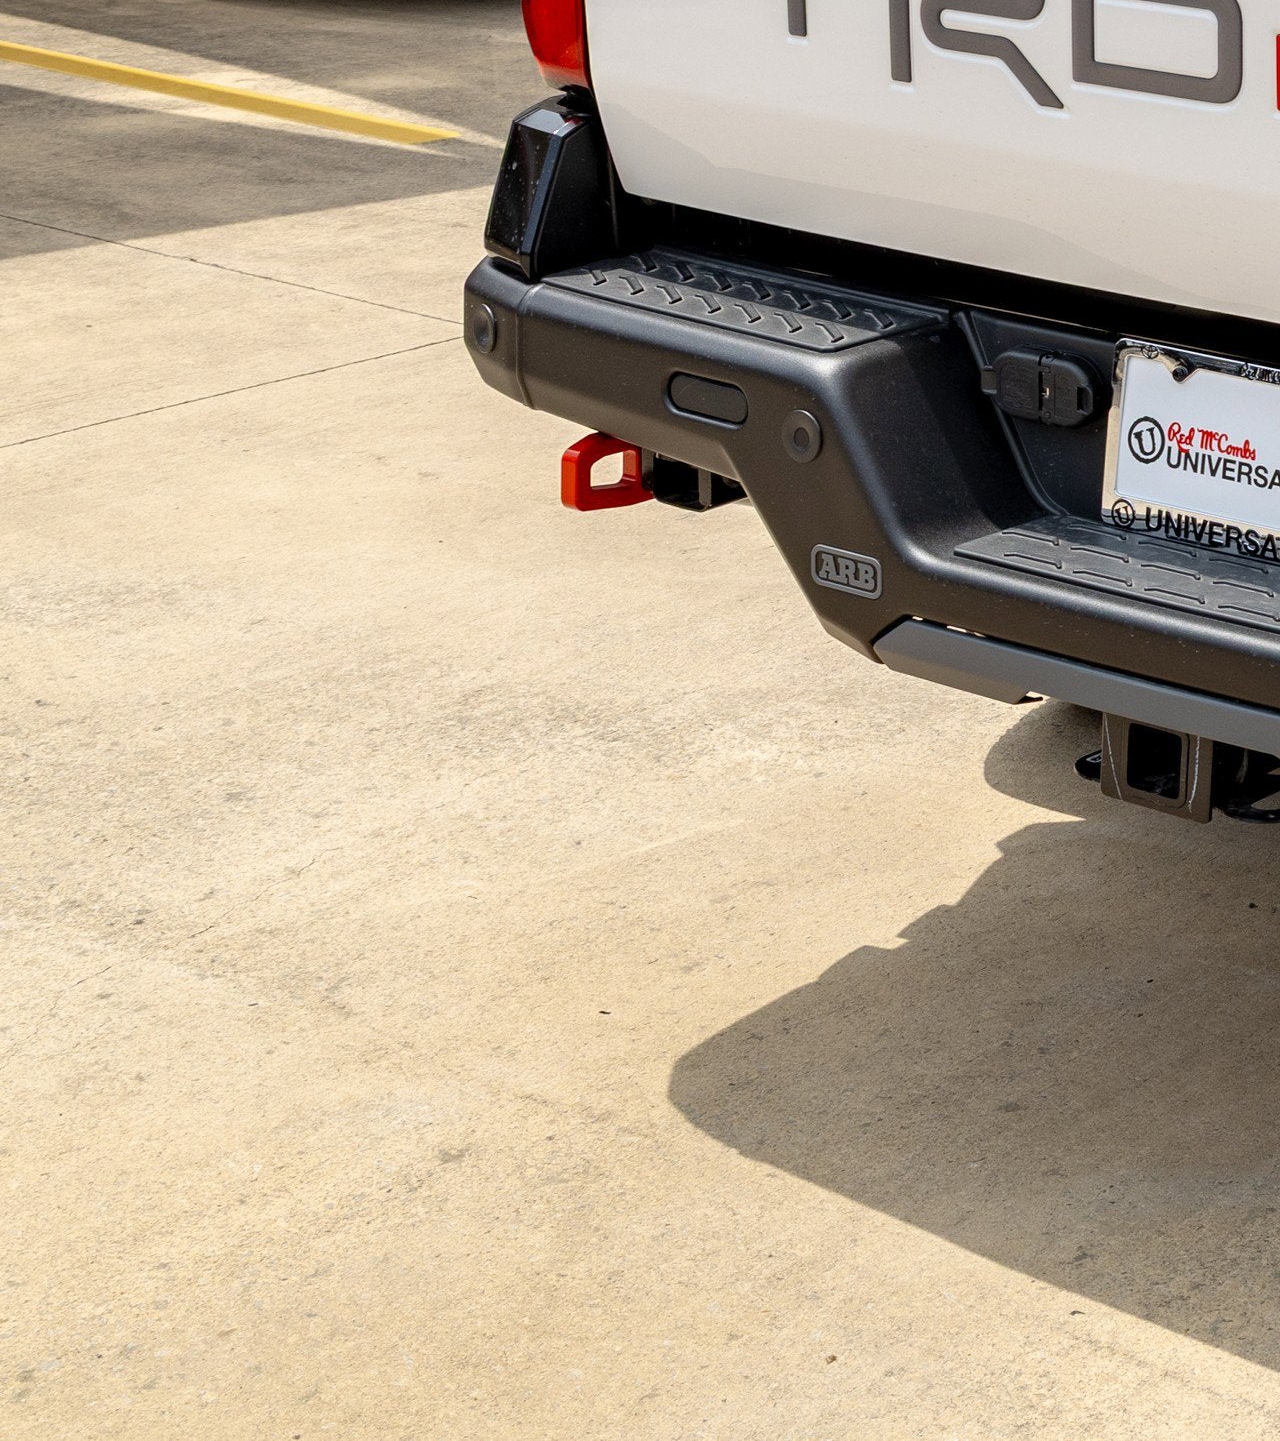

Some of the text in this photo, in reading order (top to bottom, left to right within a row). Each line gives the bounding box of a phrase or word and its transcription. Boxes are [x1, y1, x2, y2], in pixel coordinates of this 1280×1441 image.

[1167, 421, 1257, 462] Red McCombs
[818, 552, 876, 591] ARB
